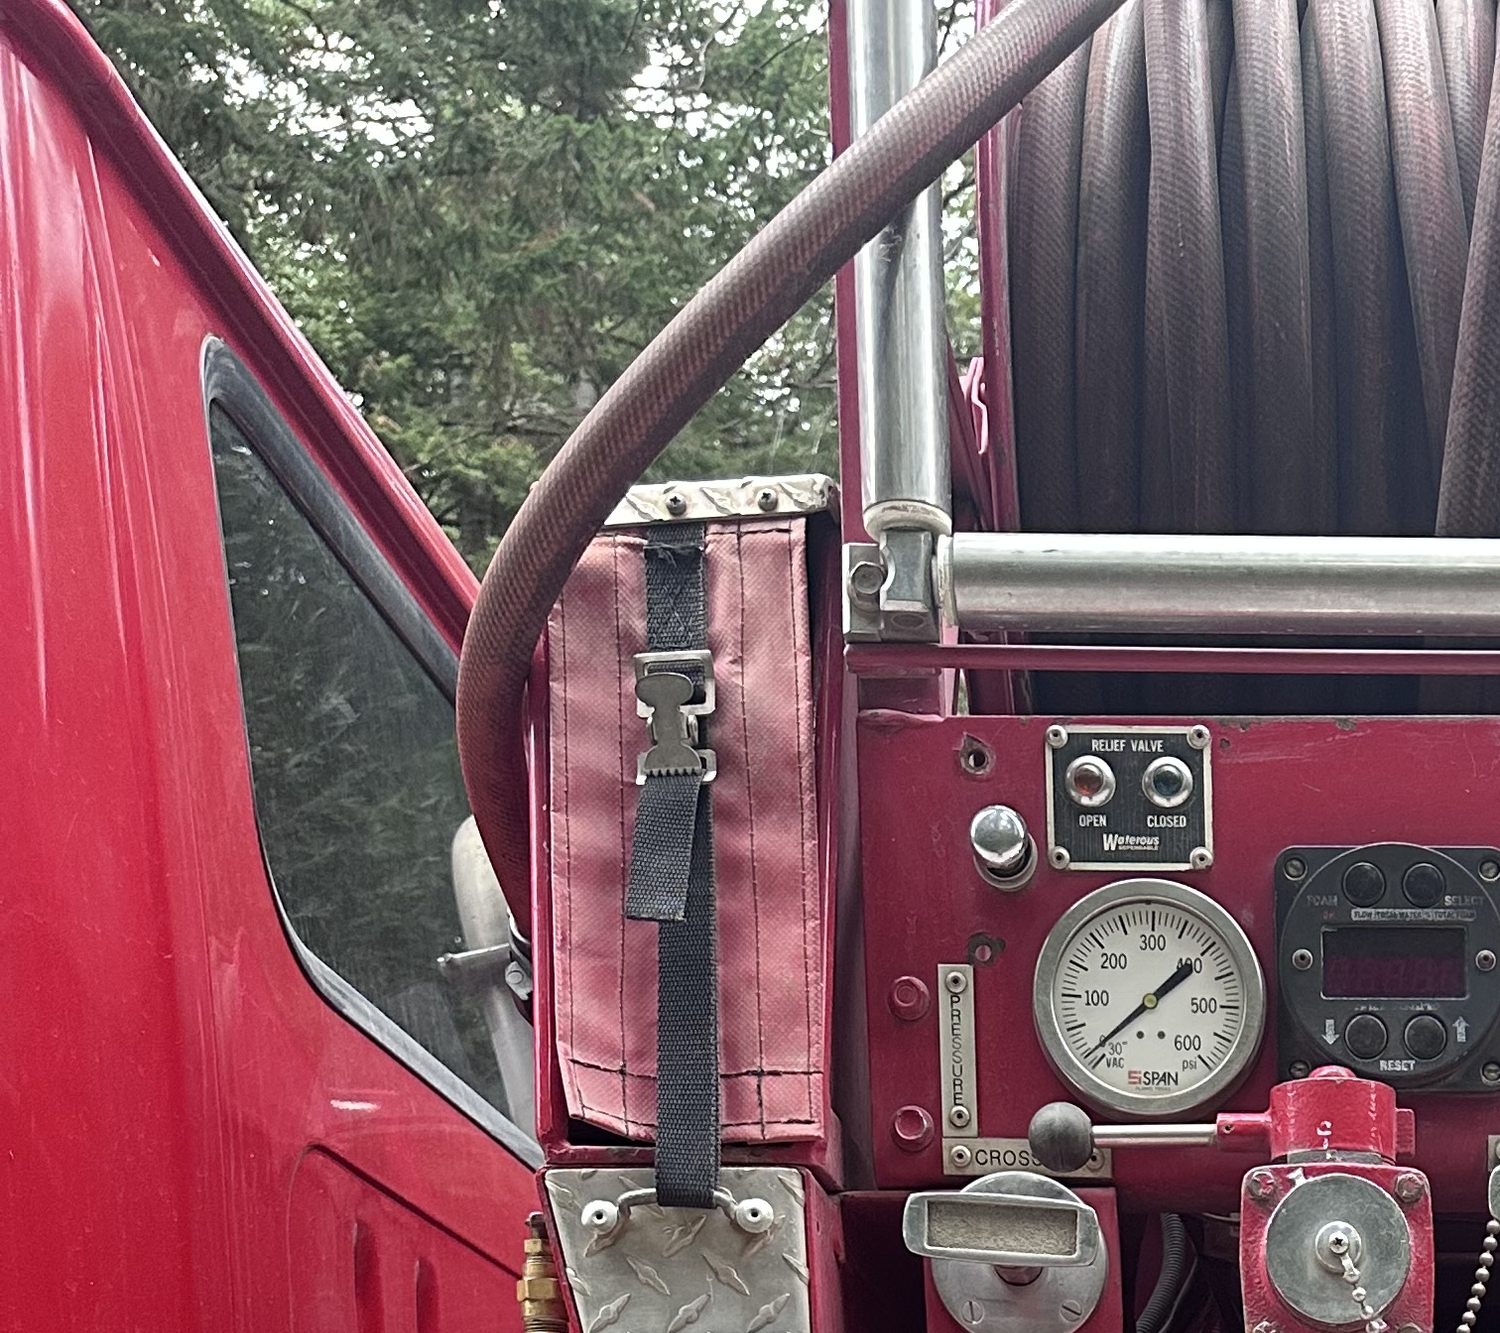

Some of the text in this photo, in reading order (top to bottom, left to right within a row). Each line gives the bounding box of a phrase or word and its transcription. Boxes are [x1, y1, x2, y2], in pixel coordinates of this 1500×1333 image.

[1091, 739, 1164, 752] RELIEF VALVE
[1079, 815, 1106, 827] OPEN
[1147, 815, 1187, 828] CLOSED
[1103, 833, 1160, 851] Waterous
[1139, 934, 1166, 951] 300
[1100, 953, 1127, 970] 200
[1084, 990, 1110, 1006] 100
[1191, 997, 1217, 1014] 500
[950, 995, 963, 1106] PRESSURE
[1174, 1035, 1202, 1051] 600
[1106, 1057, 1125, 1069] VAC
[1182, 1057, 1198, 1072] psi
[1380, 1060, 1416, 1071] RESET
[1143, 1071, 1179, 1086] SPAN
